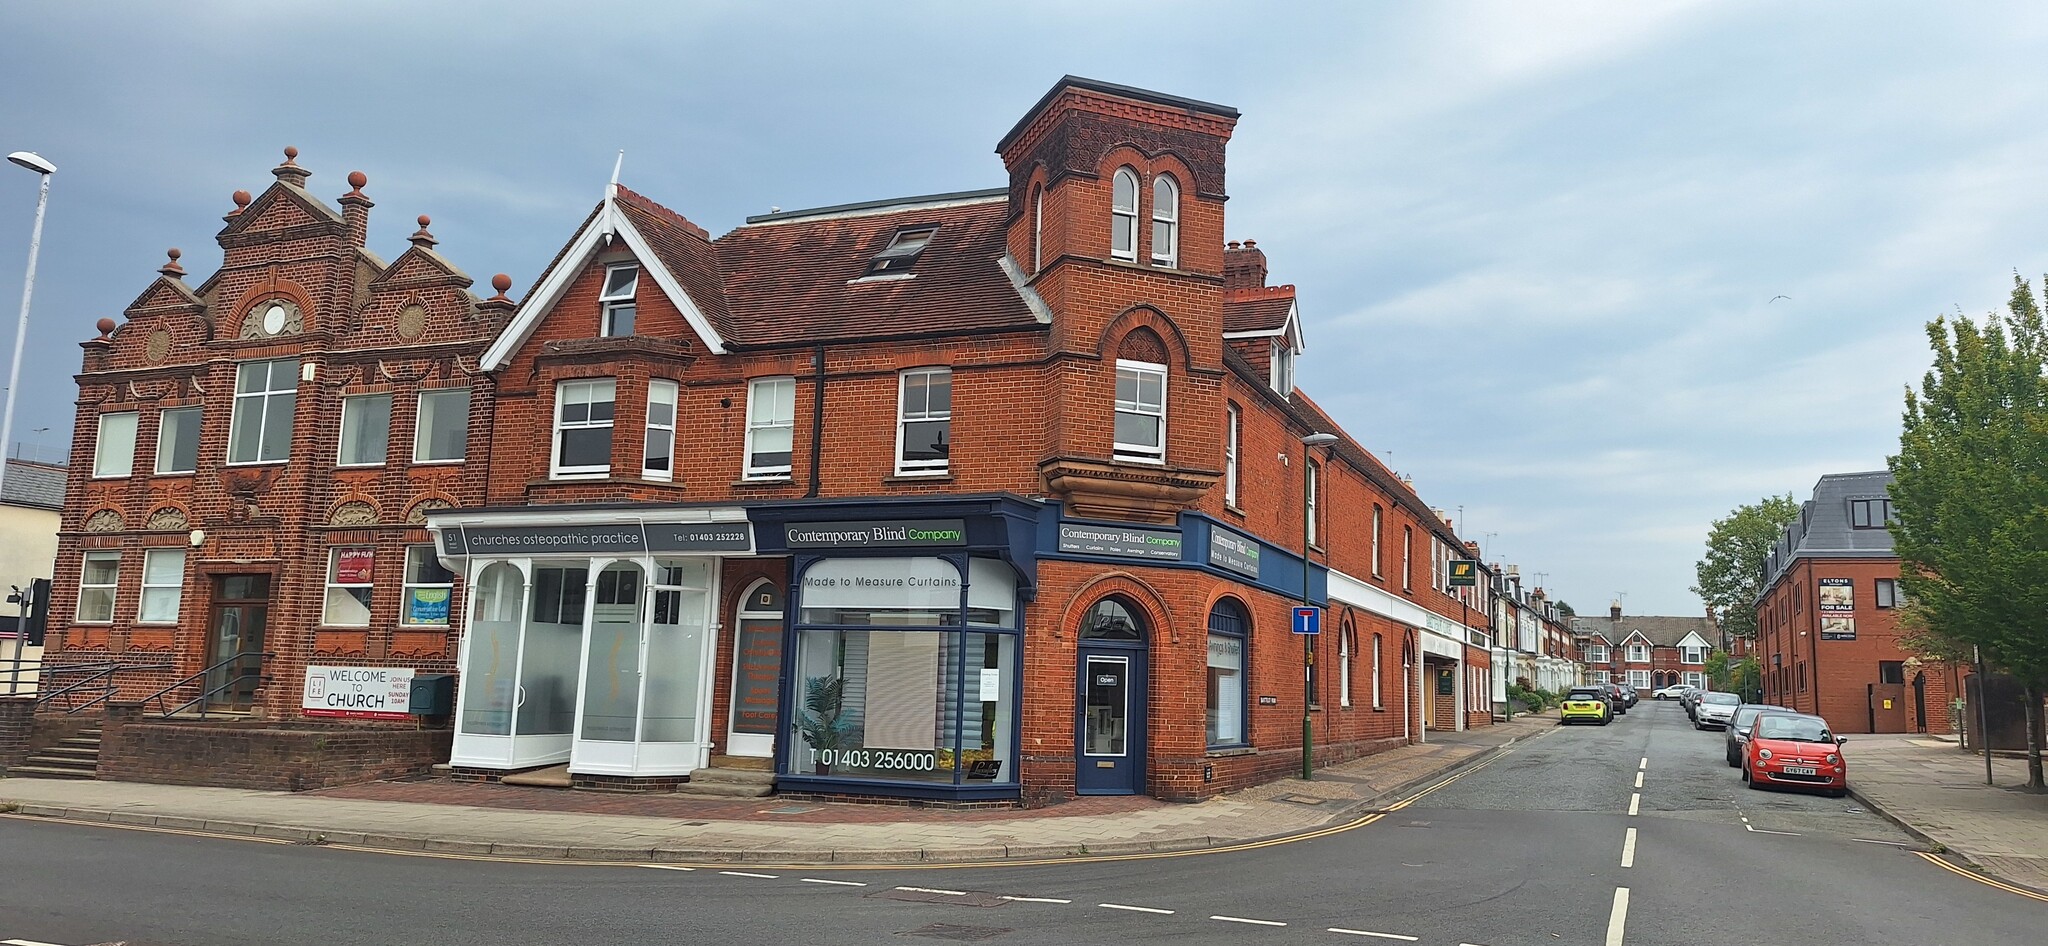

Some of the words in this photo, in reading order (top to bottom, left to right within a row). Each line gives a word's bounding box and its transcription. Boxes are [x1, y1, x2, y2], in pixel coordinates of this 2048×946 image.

[448, 533, 457, 542] 51
[471, 533, 521, 546] churches
[523, 532, 590, 547] osteopathic
[591, 531, 639, 546] practice
[673, 533, 688, 542] Tel:
[689, 533, 714, 542] 01403
[715, 532, 745, 542] 252228
[788, 528, 870, 545] Contemporary
[872, 526, 907, 541] Blind
[908, 528, 961, 542] Company
[1061, 527, 1121, 544] Contemporary
[1122, 532, 1145, 544] Blind
[1146, 536, 1181, 548] Company
[1211, 530, 1237, 554] Contemporary
[1236, 540, 1247, 555] Blind
[340, 551, 361, 559] HAPPY
[804, 576, 836, 587] Made
[840, 576, 851, 587] to
[855, 576, 904, 587] Measure
[329, 669, 387, 683] WELCOME
[351, 683, 363, 692] TO
[327, 692, 385, 708] CHURCH
[742, 710, 757, 718] Foot
[821, 747, 870, 768] 01403
[875, 751, 935, 771] 256000
